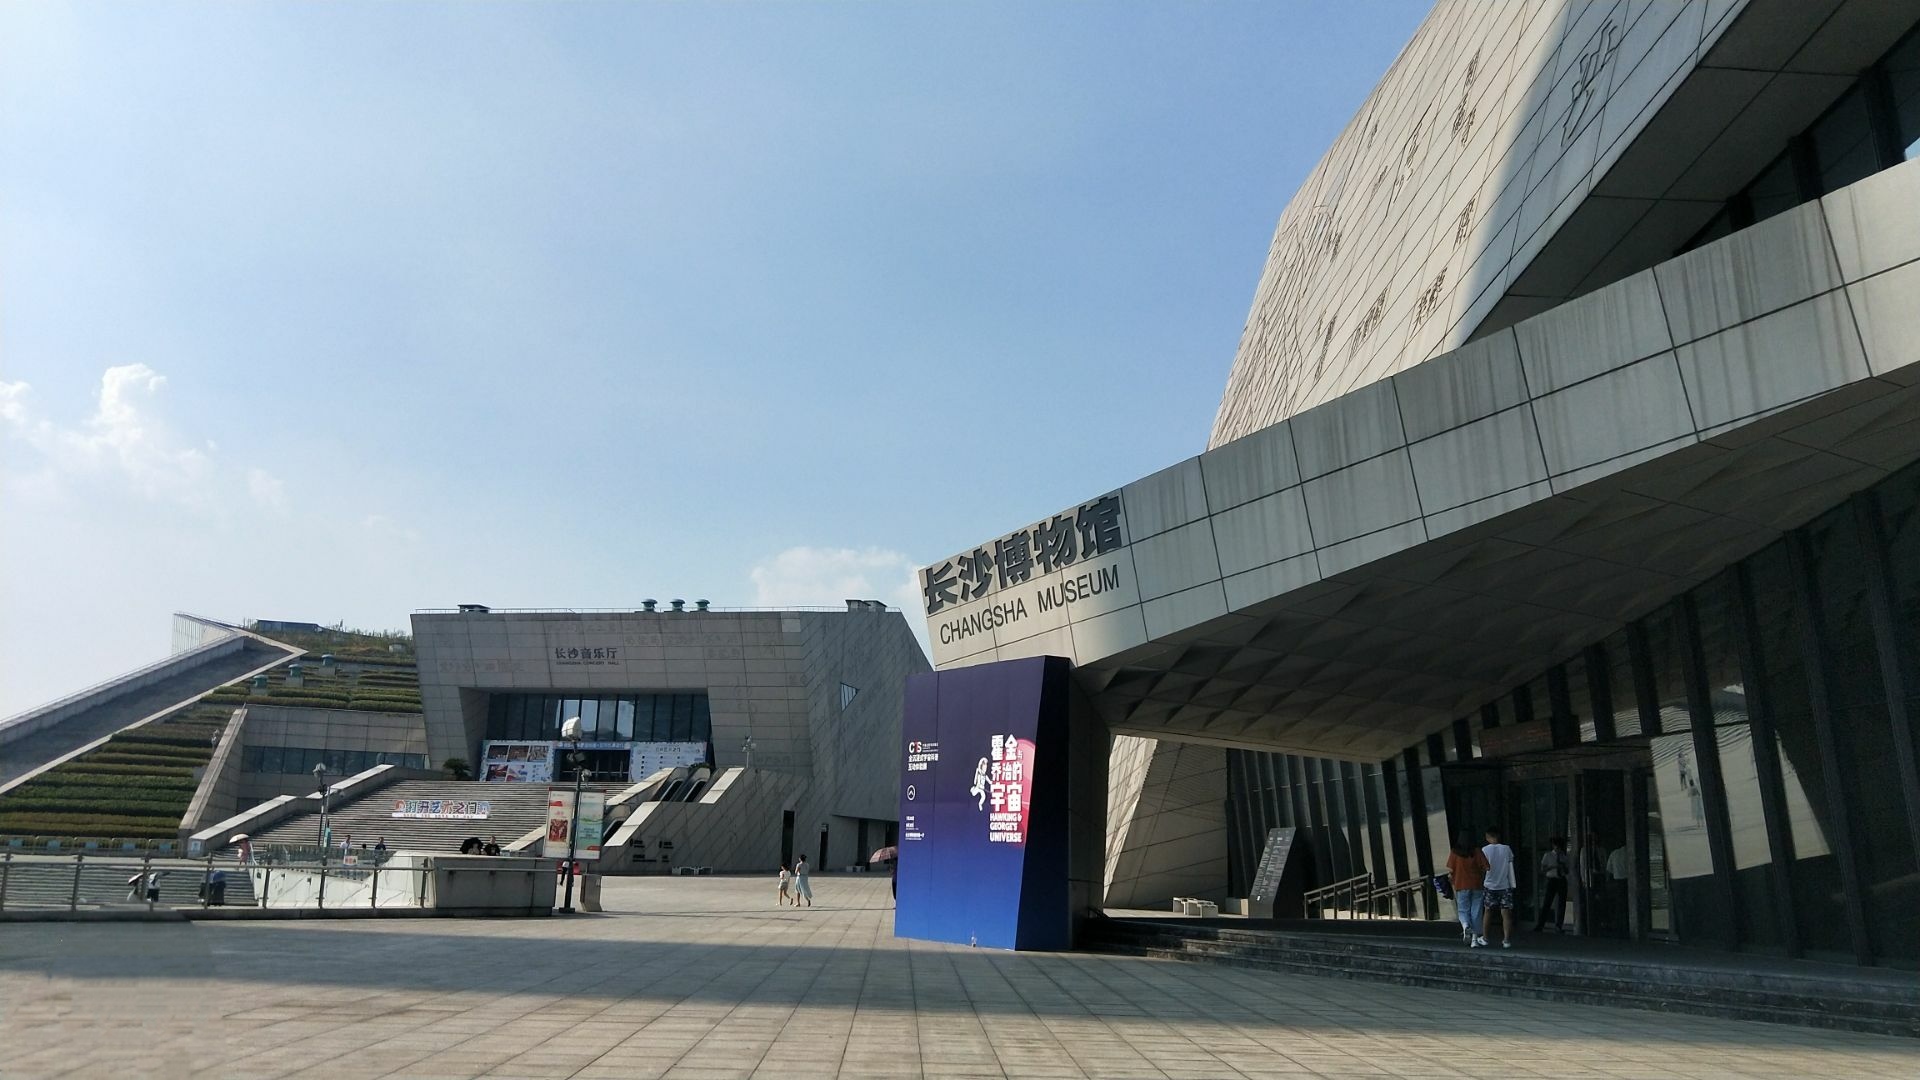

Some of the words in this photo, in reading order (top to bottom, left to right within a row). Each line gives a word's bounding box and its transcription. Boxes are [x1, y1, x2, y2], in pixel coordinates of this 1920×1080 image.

[924, 495, 1122, 614] 长沙博物馆
[940, 597, 1028, 645] CHANGSHA
[1037, 564, 1120, 613] MUSEUM
[555, 648, 617, 659] 长沙音乐厅
[991, 762, 1023, 781] 乔治的
[990, 782, 1023, 812] 宇宙
[990, 812, 1018, 821] HAWKING
[990, 832, 1022, 842] UNIVERSE
